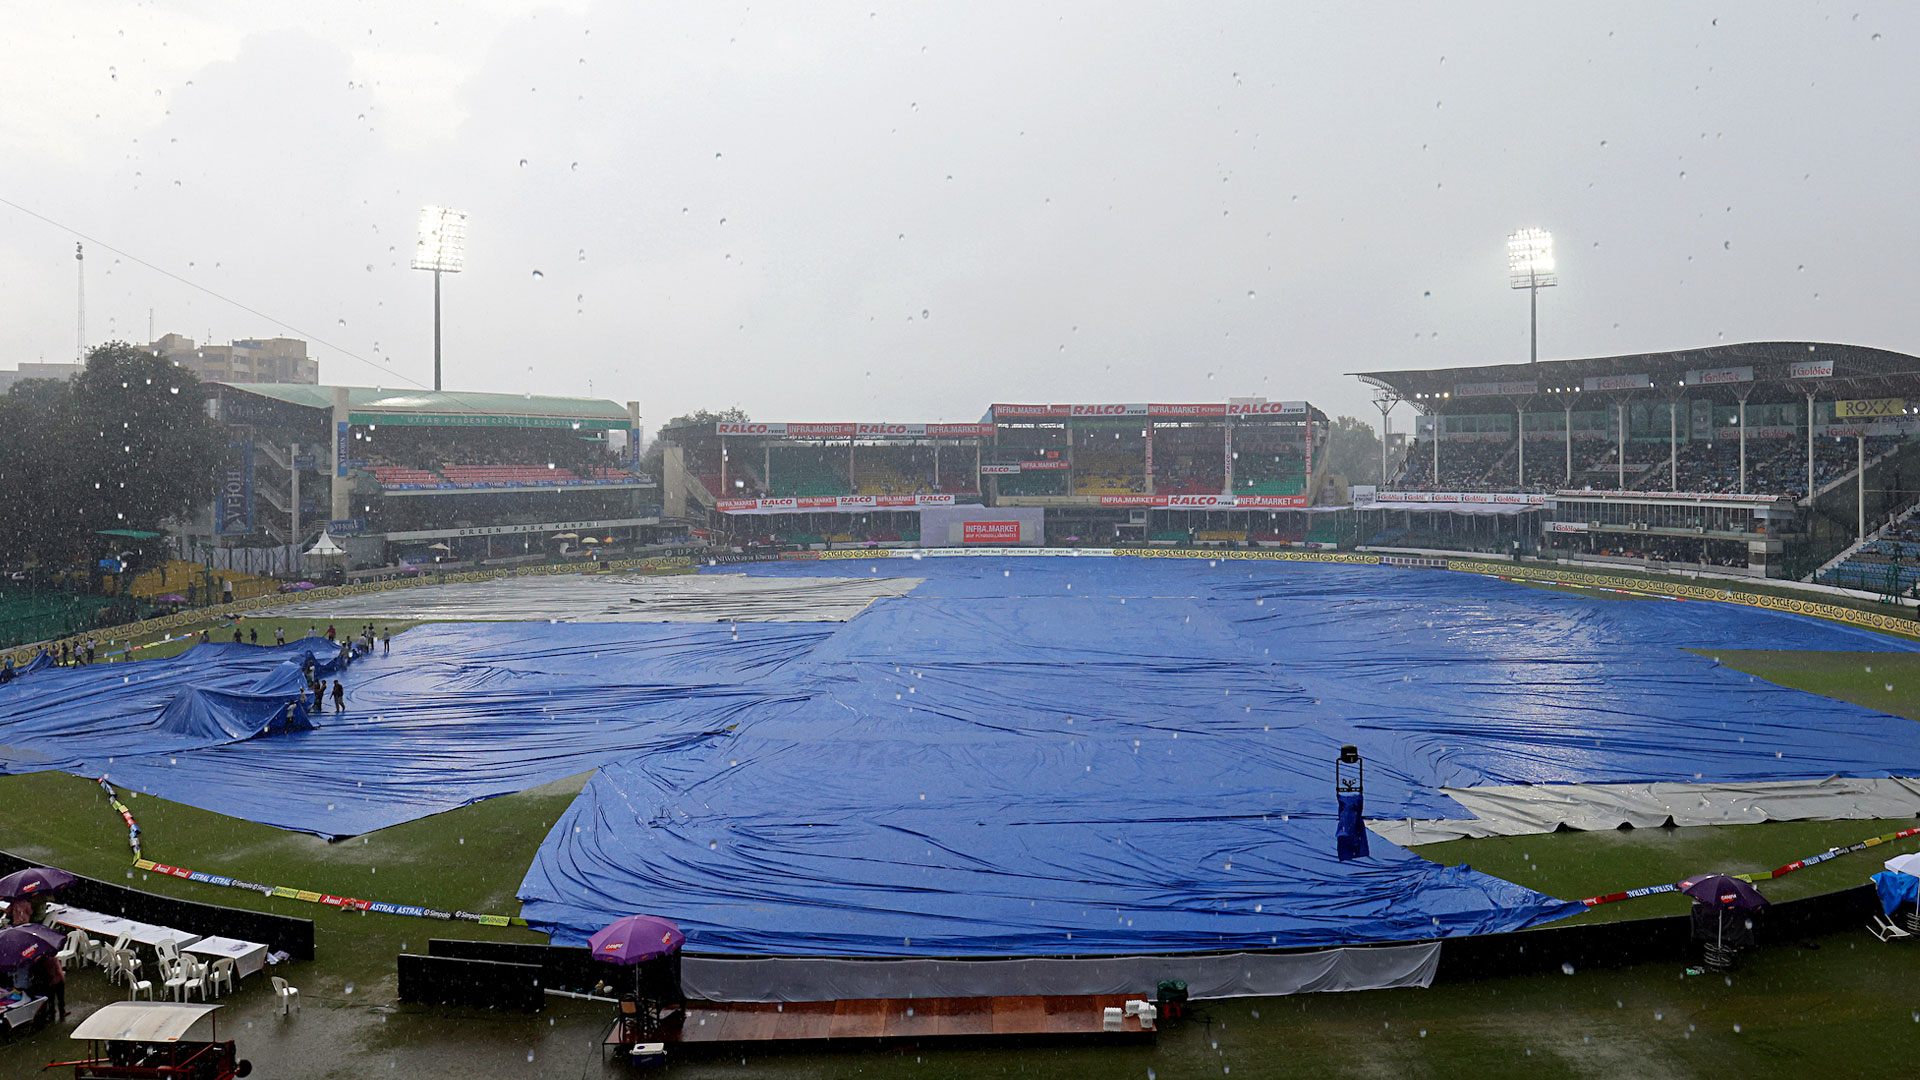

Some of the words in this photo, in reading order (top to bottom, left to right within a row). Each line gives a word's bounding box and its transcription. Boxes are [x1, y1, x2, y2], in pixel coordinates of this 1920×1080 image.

[996, 406, 1045, 414] INFRA.MARKET
[1072, 405, 1126, 414] RALCO
[1148, 406, 1200, 414] INFRA.MARKET
[1228, 403, 1282, 414] RALCO
[1846, 400, 1894, 415] ROXX
[719, 424, 768, 434] RALCO
[790, 425, 842, 433] INFRA.MARKET
[858, 425, 907, 434] RALCO
[226, 471, 244, 520] VI-JOH
[1170, 496, 1217, 505] RALCO
[460, 528, 502, 536] GREEN
[678, 548, 708, 556] UPCA
[716, 554, 741, 562] NIWAS
[1460, 562, 1475, 570] CYCLE
[1568, 572, 1585, 581] CYCLE
[1608, 576, 1624, 585] CYCLE
[1648, 580, 1665, 589] CYCLE
[1688, 586, 1705, 594] CYCLE
[1772, 596, 1790, 607] CYCLE
[1814, 604, 1833, 614] CYCLE
[1855, 610, 1873, 621] CYCLE
[1896, 618, 1914, 630] CYCLE
[172, 868, 189, 878] Amul
[190, 872, 210, 882] ASTRAL
[209, 876, 232, 886] ASTRAL
[1627, 888, 1650, 898] ASTRAL
[1650, 884, 1675, 894] ASTRAL
[323, 896, 342, 904] Amul
[370, 903, 396, 912] ASTRAL
[396, 906, 424, 916] ASTRAL
[430, 910, 452, 918] Simpolo
